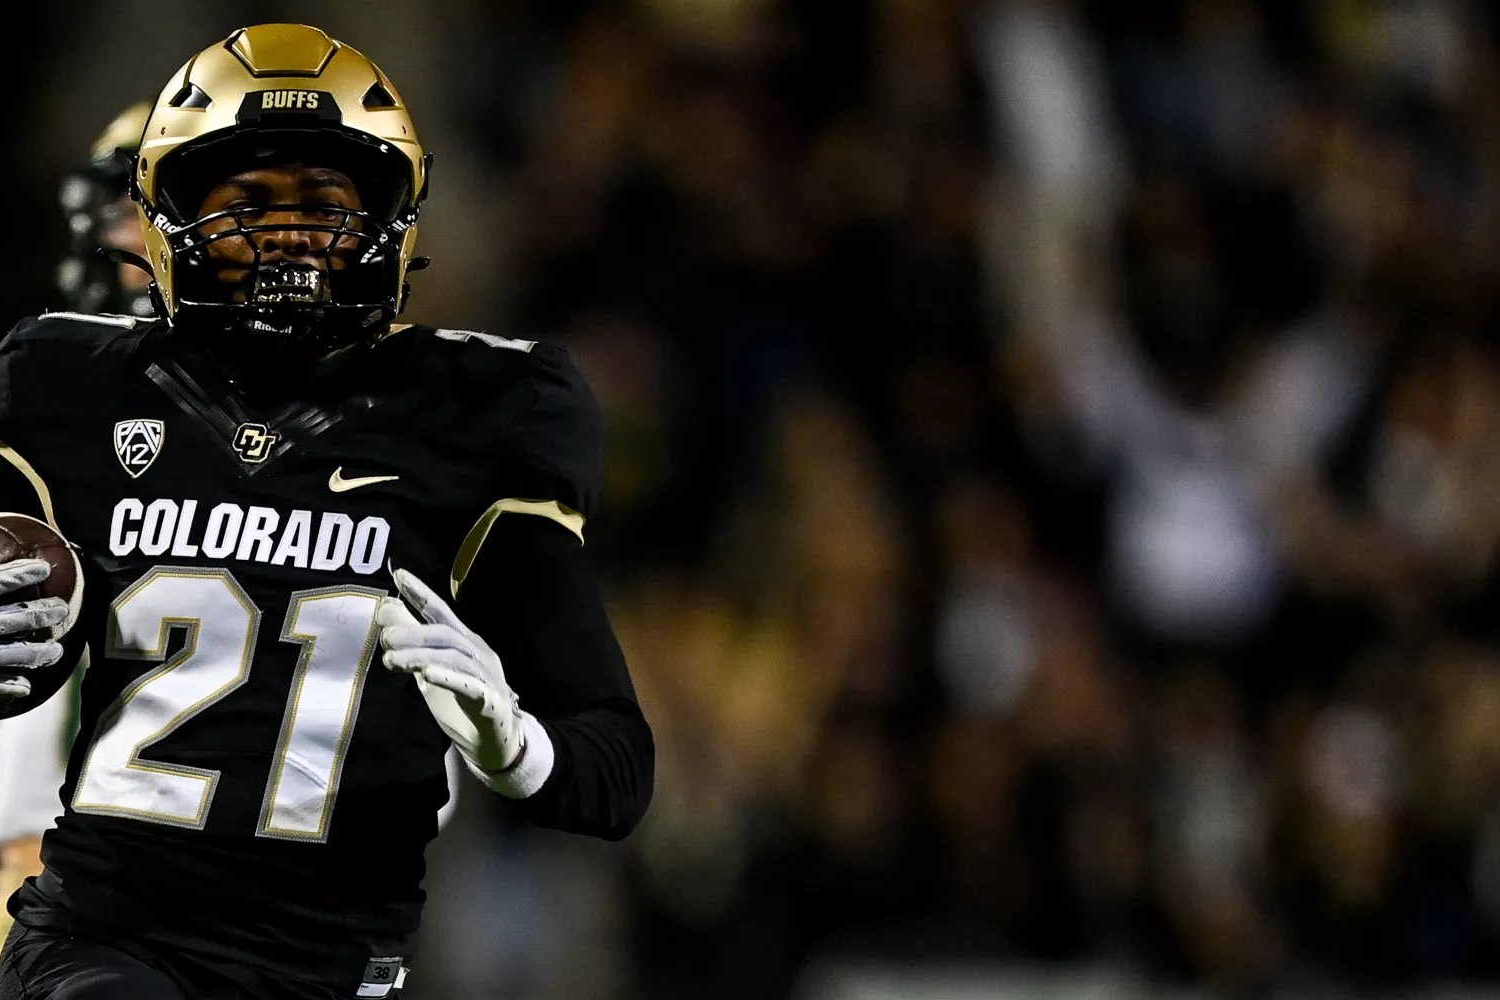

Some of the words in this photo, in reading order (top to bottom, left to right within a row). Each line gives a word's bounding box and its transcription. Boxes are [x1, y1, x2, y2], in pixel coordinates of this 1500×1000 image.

[261, 90, 319, 109] BUFFS
[116, 421, 161, 455] PAC
[125, 443, 151, 465] 12
[109, 497, 391, 575] COLORADO
[70, 565, 389, 844] 21
[373, 966, 390, 980] 38
